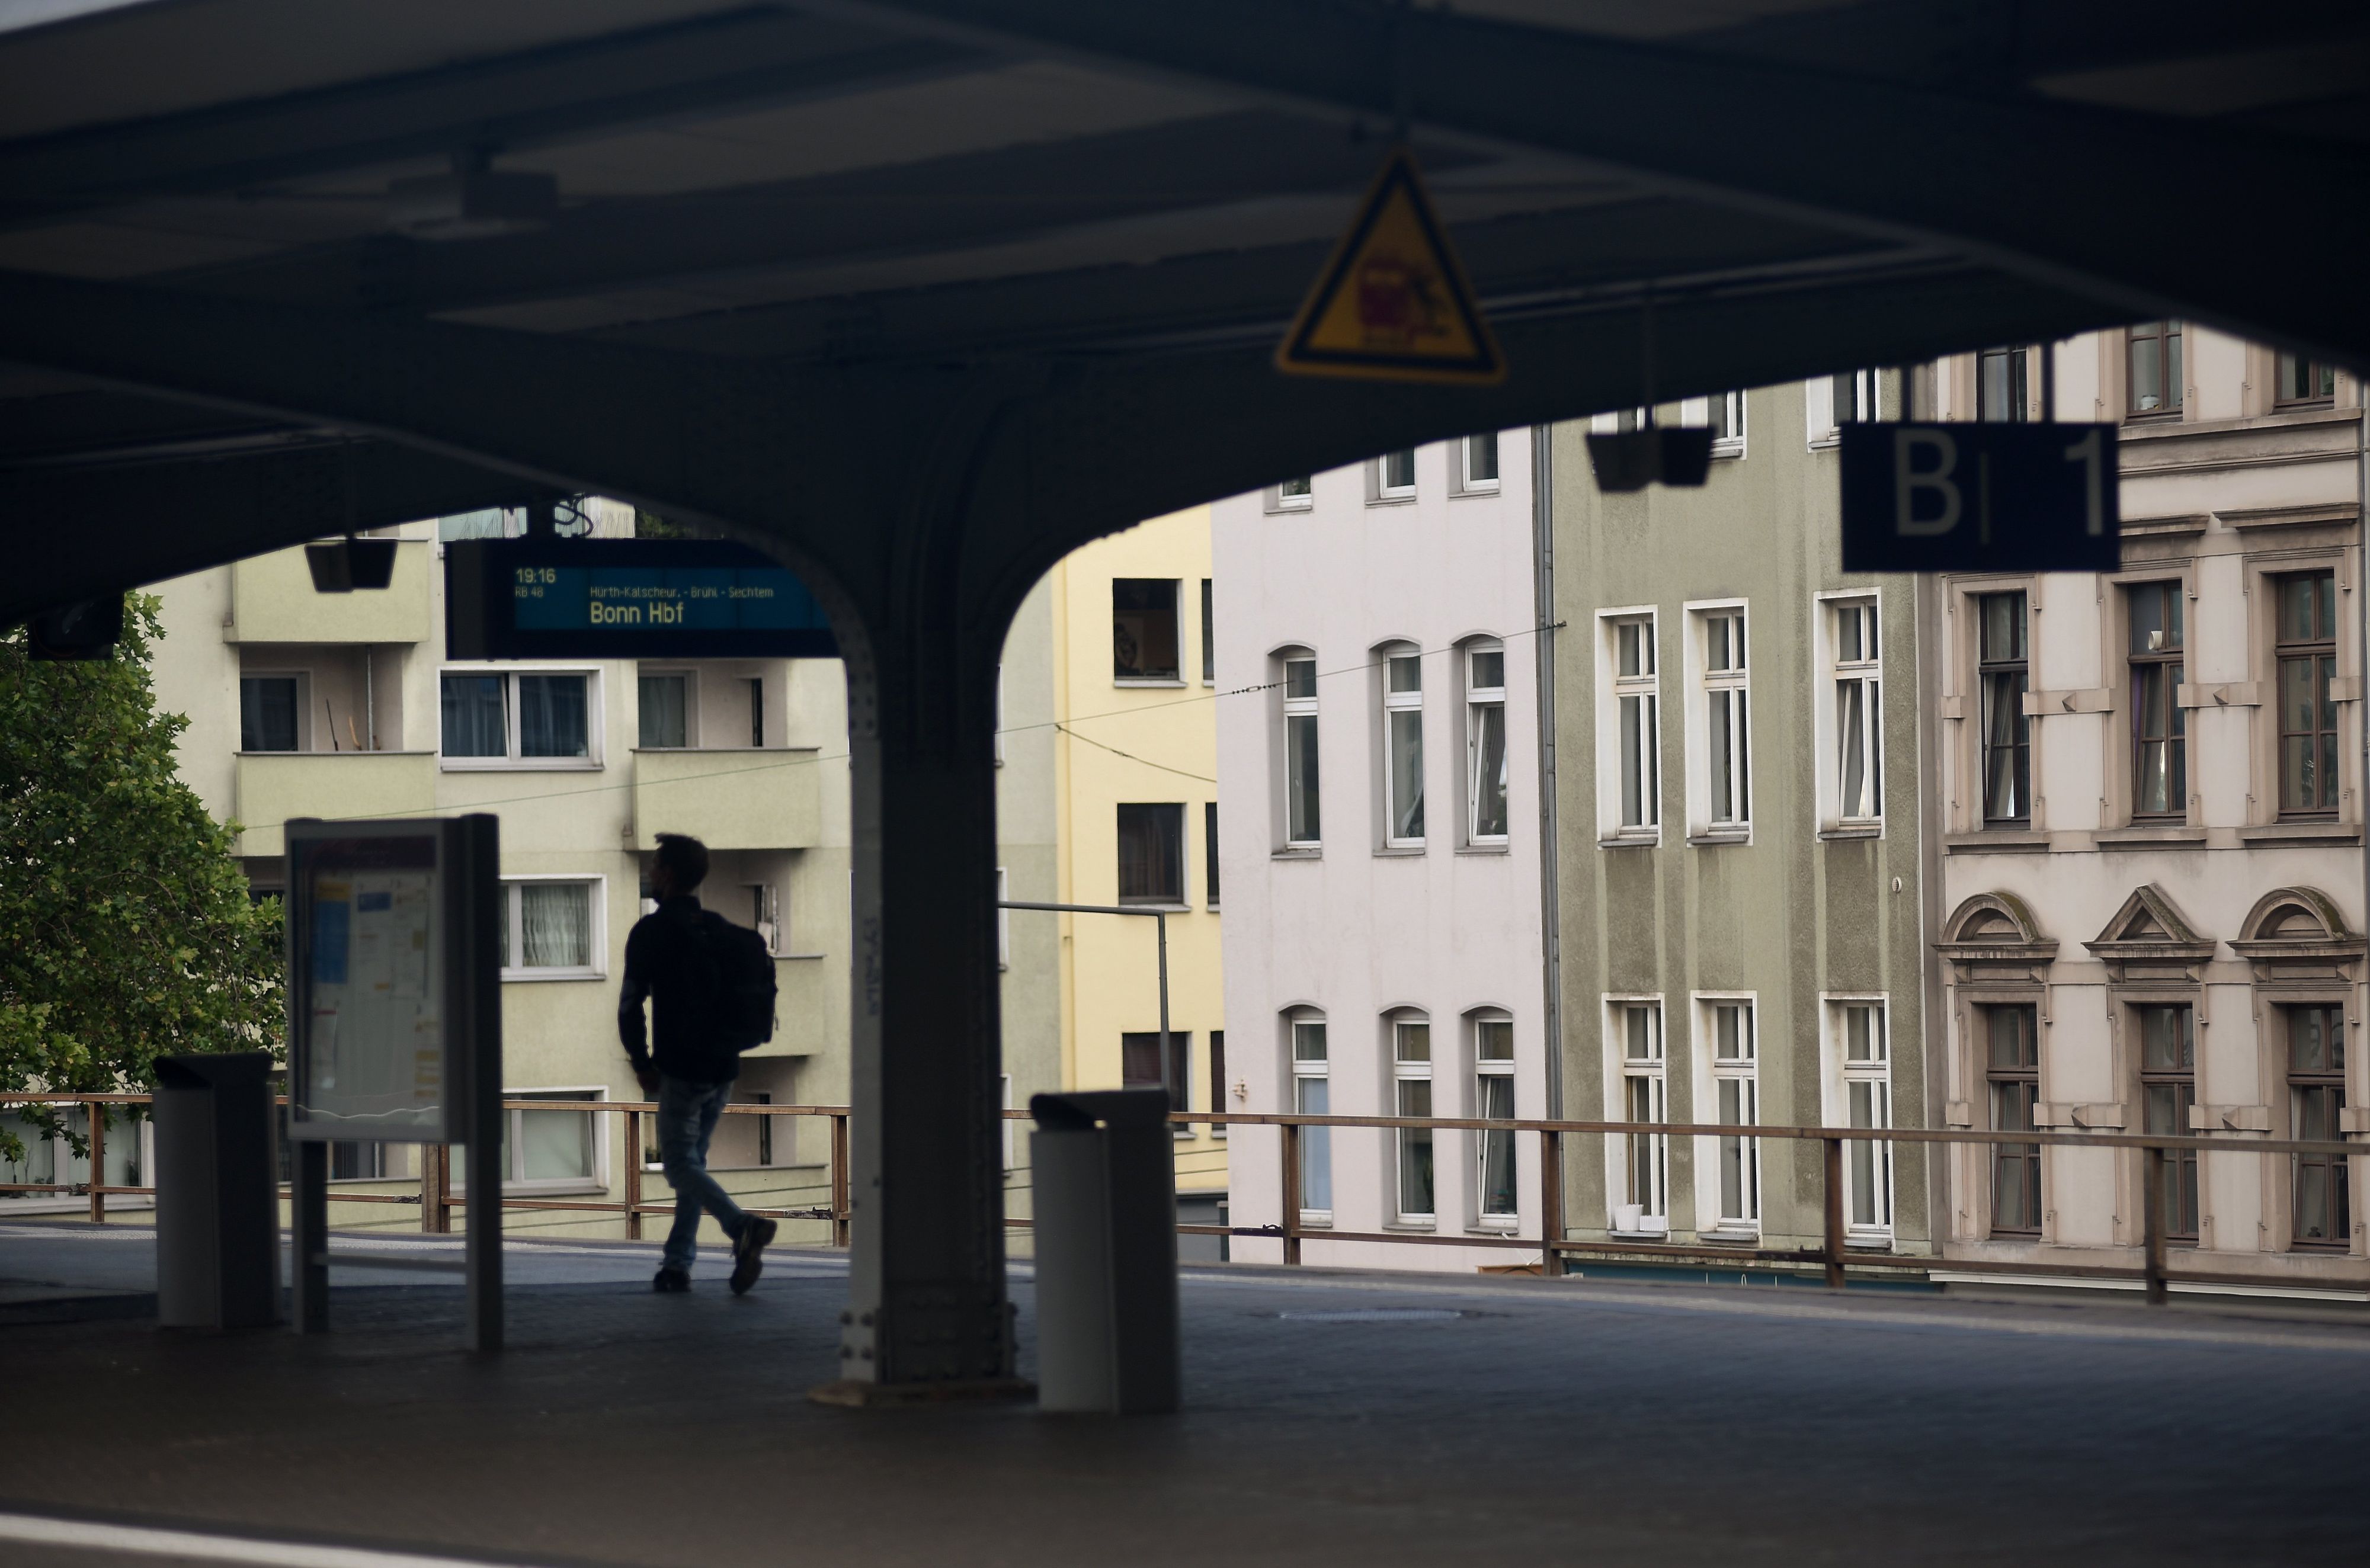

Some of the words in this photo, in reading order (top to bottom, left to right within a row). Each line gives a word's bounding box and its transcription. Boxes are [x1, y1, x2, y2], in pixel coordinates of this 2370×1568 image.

[1894, 428, 1962, 537] B
[2064, 428, 2104, 537] 1
[516, 568, 557, 584] 19:16
[515, 586, 527, 597] RB
[691, 586, 718, 598] Brühl
[728, 586, 774, 598] Sechtem
[590, 601, 641, 624] Bonn
[649, 601, 684, 624] Hbf
